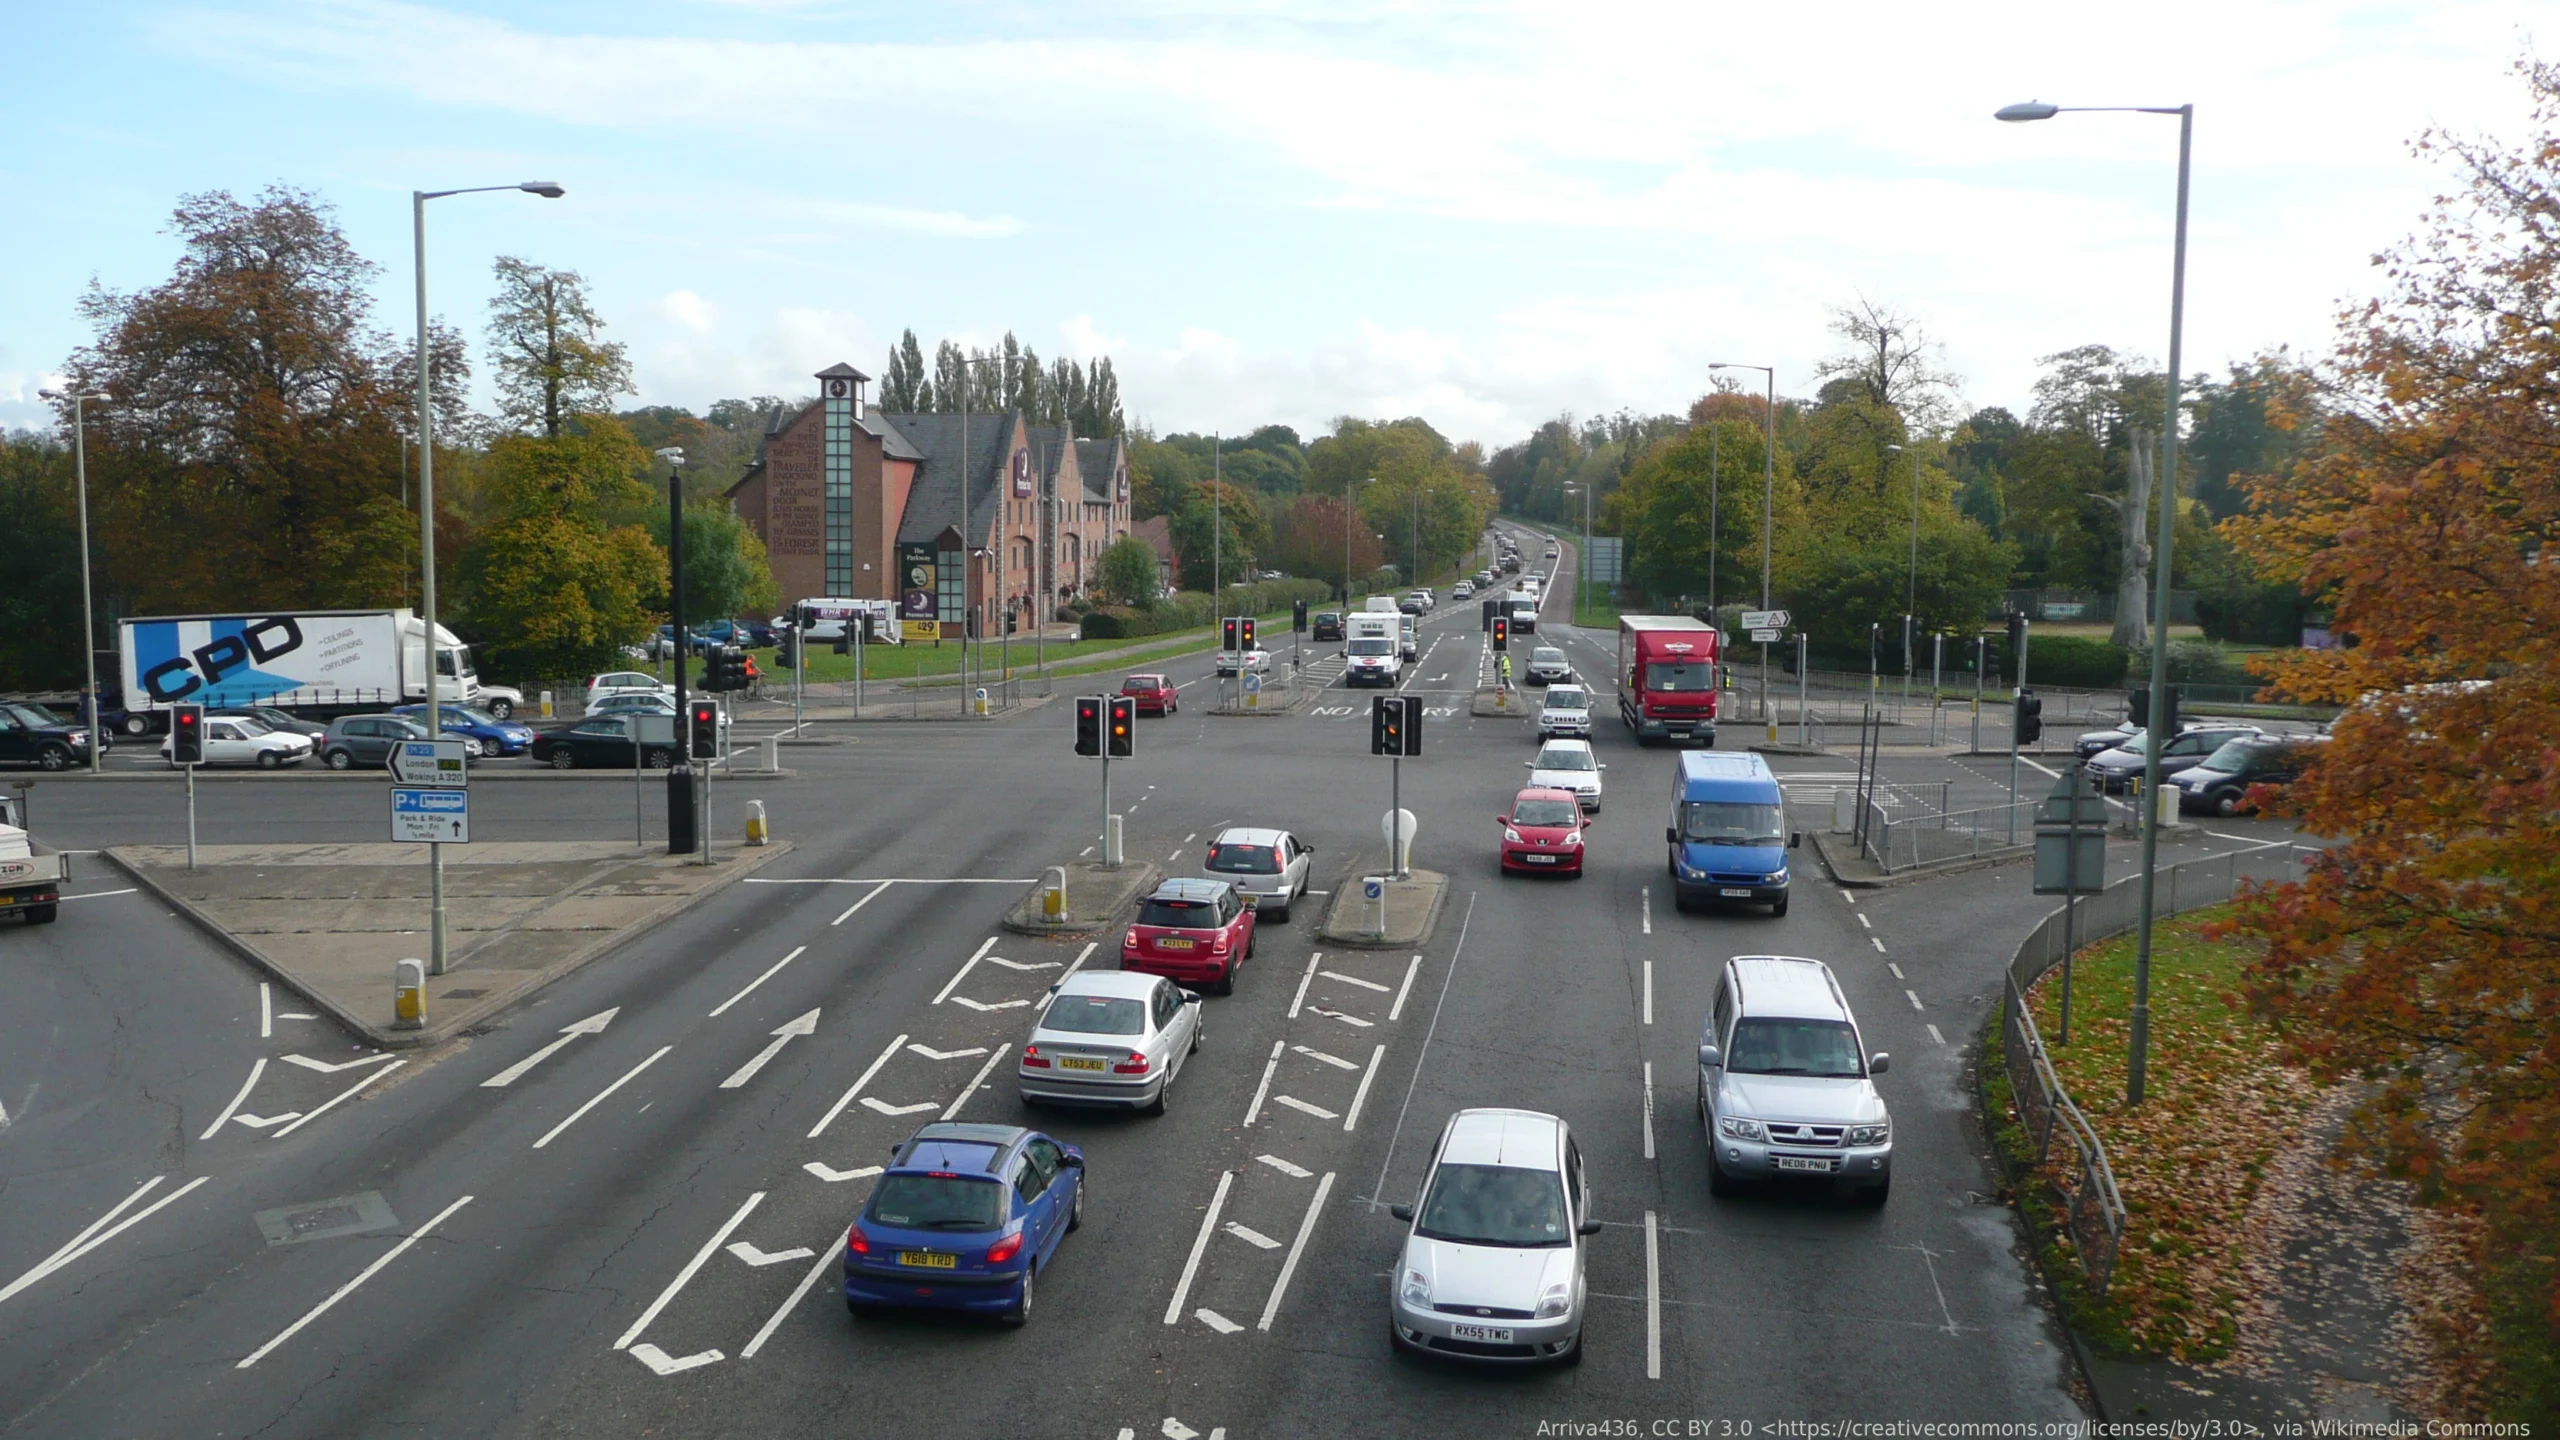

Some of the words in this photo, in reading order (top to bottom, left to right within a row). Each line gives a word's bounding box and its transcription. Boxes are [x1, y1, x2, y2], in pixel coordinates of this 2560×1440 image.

[907, 555, 931, 563] Parkway
[917, 621, 935, 632] £29
[143, 616, 304, 703] CPD
[1311, 706, 1354, 716] NO
[406, 759, 435, 768] London
[406, 772, 436, 782] Woking
[418, 831, 435, 839] mile
[1062, 1058, 1085, 1069] LT53
[1086, 1060, 1103, 1070] JEU
[1781, 1158, 1806, 1169] RE06
[1808, 1160, 1827, 1170] PNU
[905, 1252, 928, 1265] Y618
[930, 1254, 951, 1266] TRD
[1455, 1325, 1485, 1338] RX55
[1487, 1328, 1509, 1341] TWG
